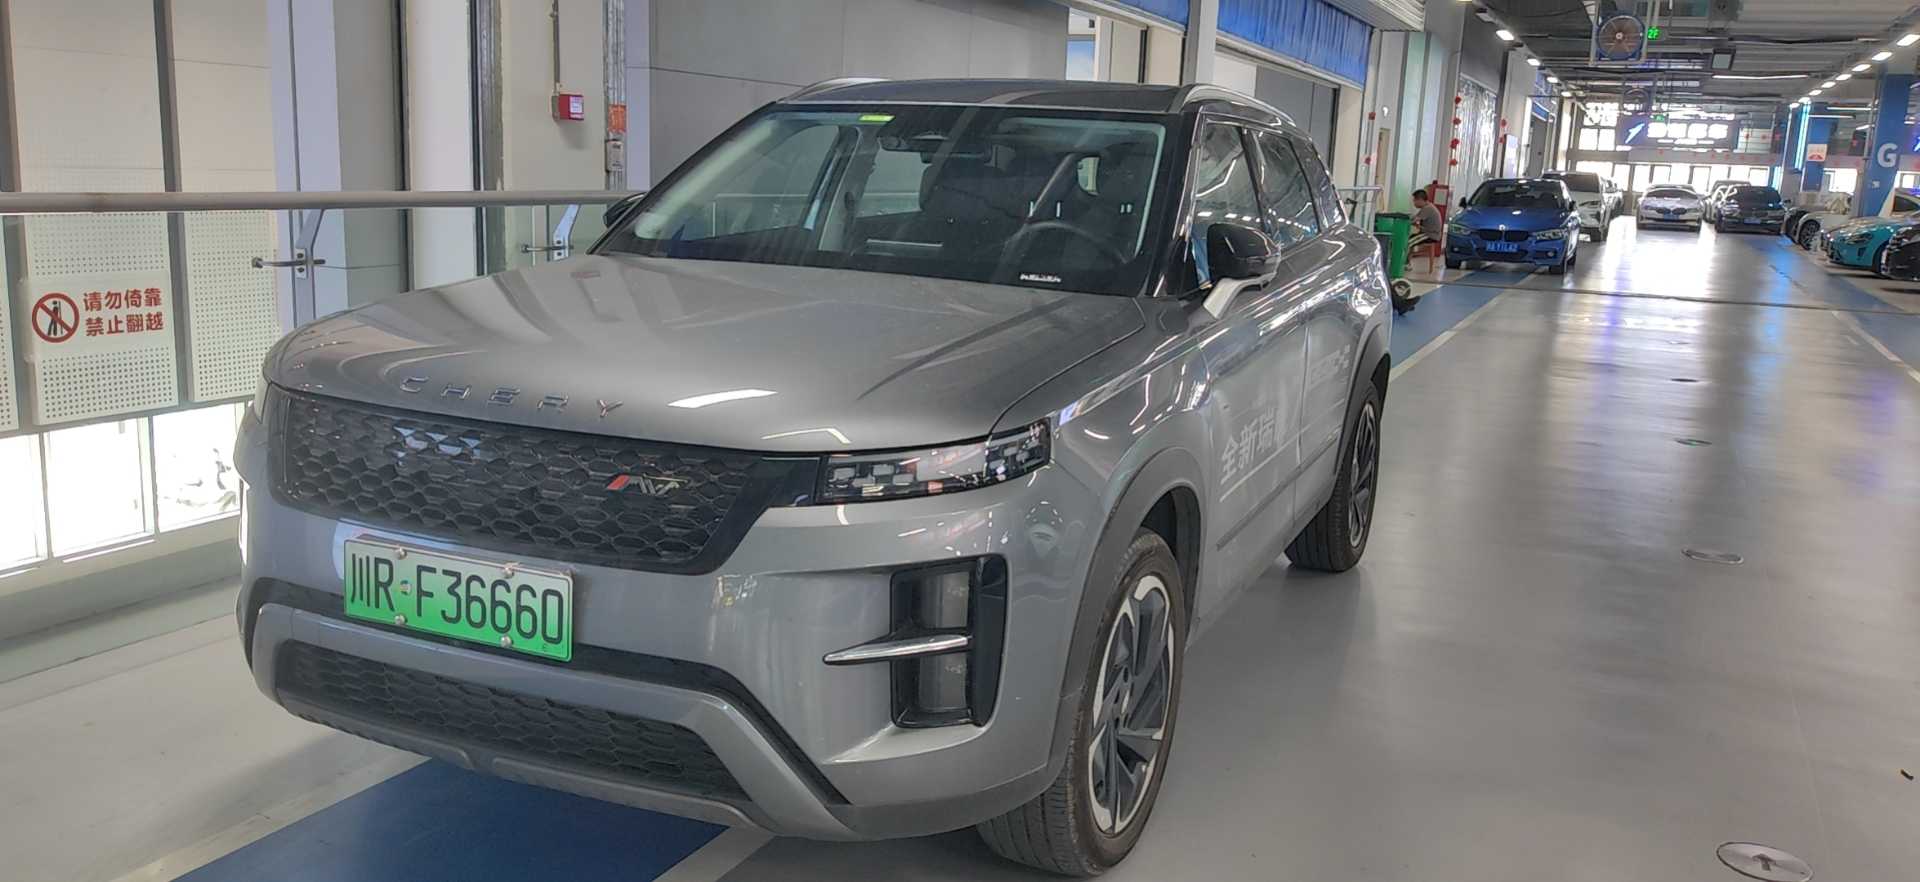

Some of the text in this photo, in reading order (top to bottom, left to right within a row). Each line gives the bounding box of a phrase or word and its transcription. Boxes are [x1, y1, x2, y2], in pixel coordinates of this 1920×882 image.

[1877, 142, 1898, 168] G
[83, 287, 162, 312] 请勿倚靠
[85, 312, 164, 337] 禁止翻越
[400, 375, 624, 418] CHERY
